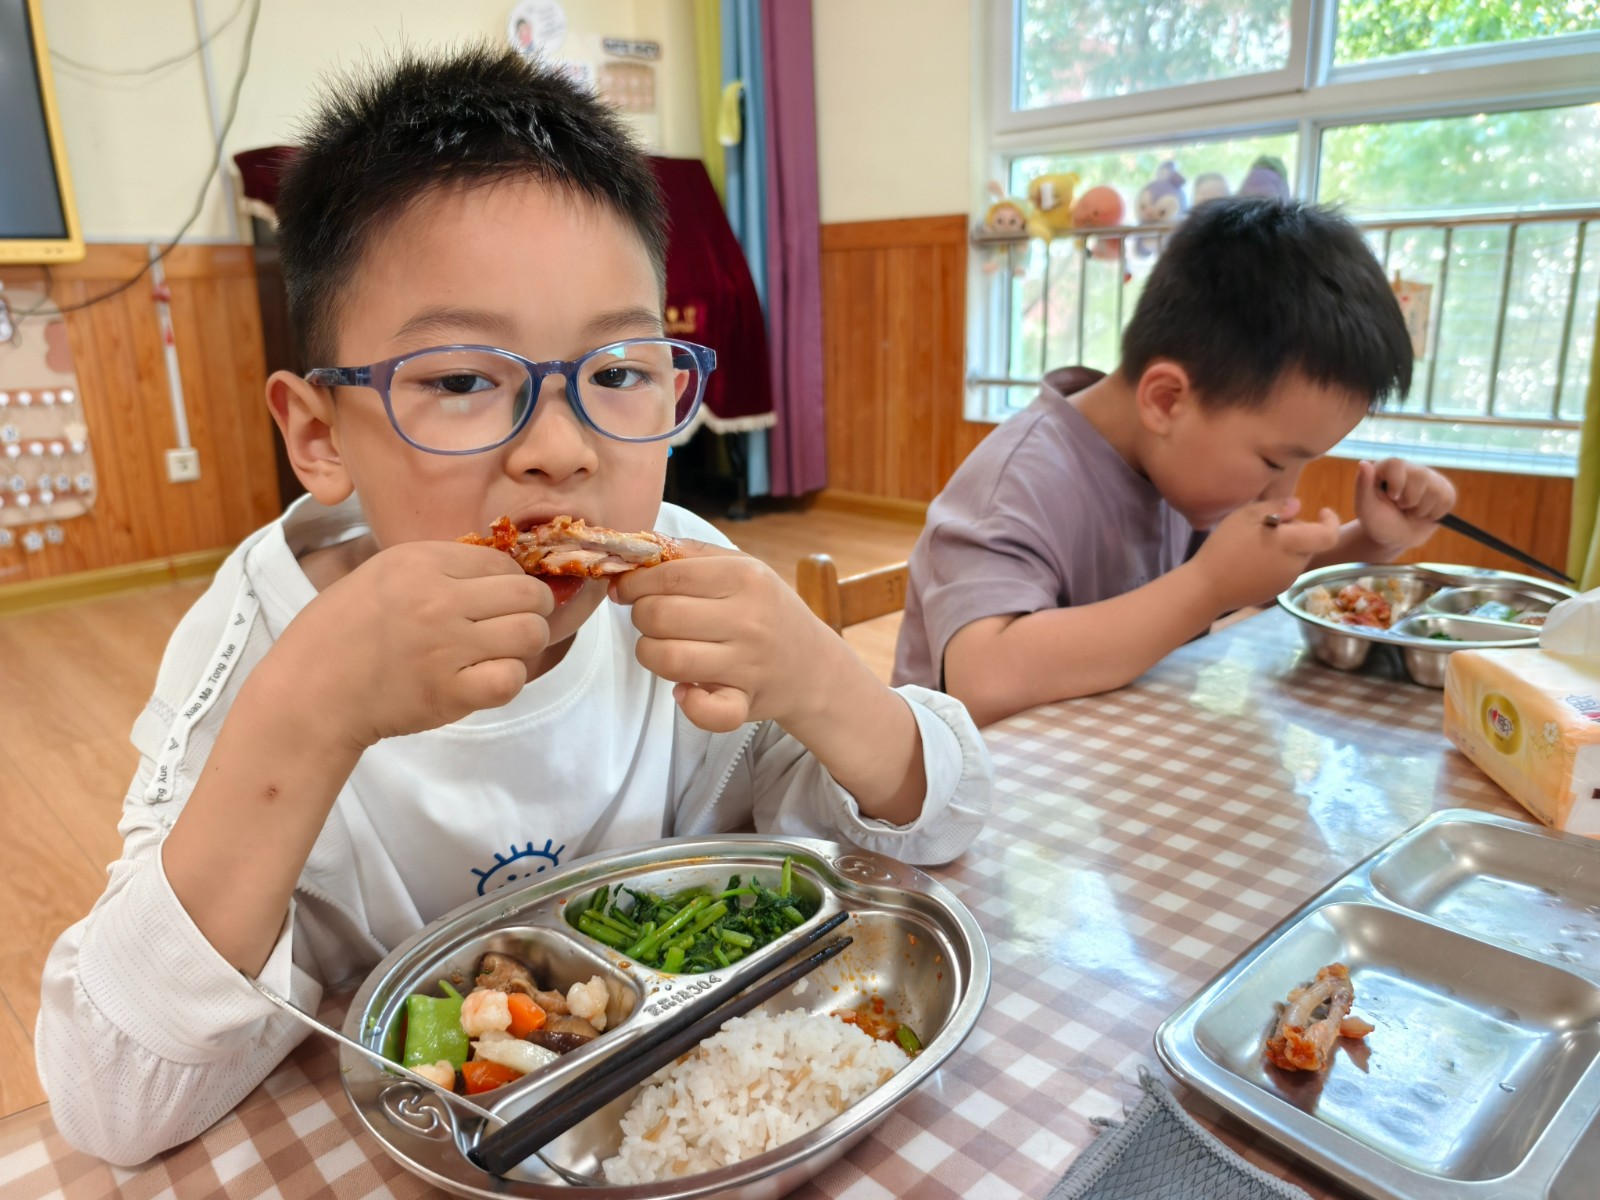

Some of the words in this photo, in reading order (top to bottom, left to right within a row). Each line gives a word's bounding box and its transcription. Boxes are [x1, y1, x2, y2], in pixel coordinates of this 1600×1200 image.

[157, 765, 168, 783] Xue
[184, 702, 202, 719] Xiao
[199, 687, 213, 701] Ma
[207, 662, 228, 684] Tong
[221, 643, 236, 660] Xue
